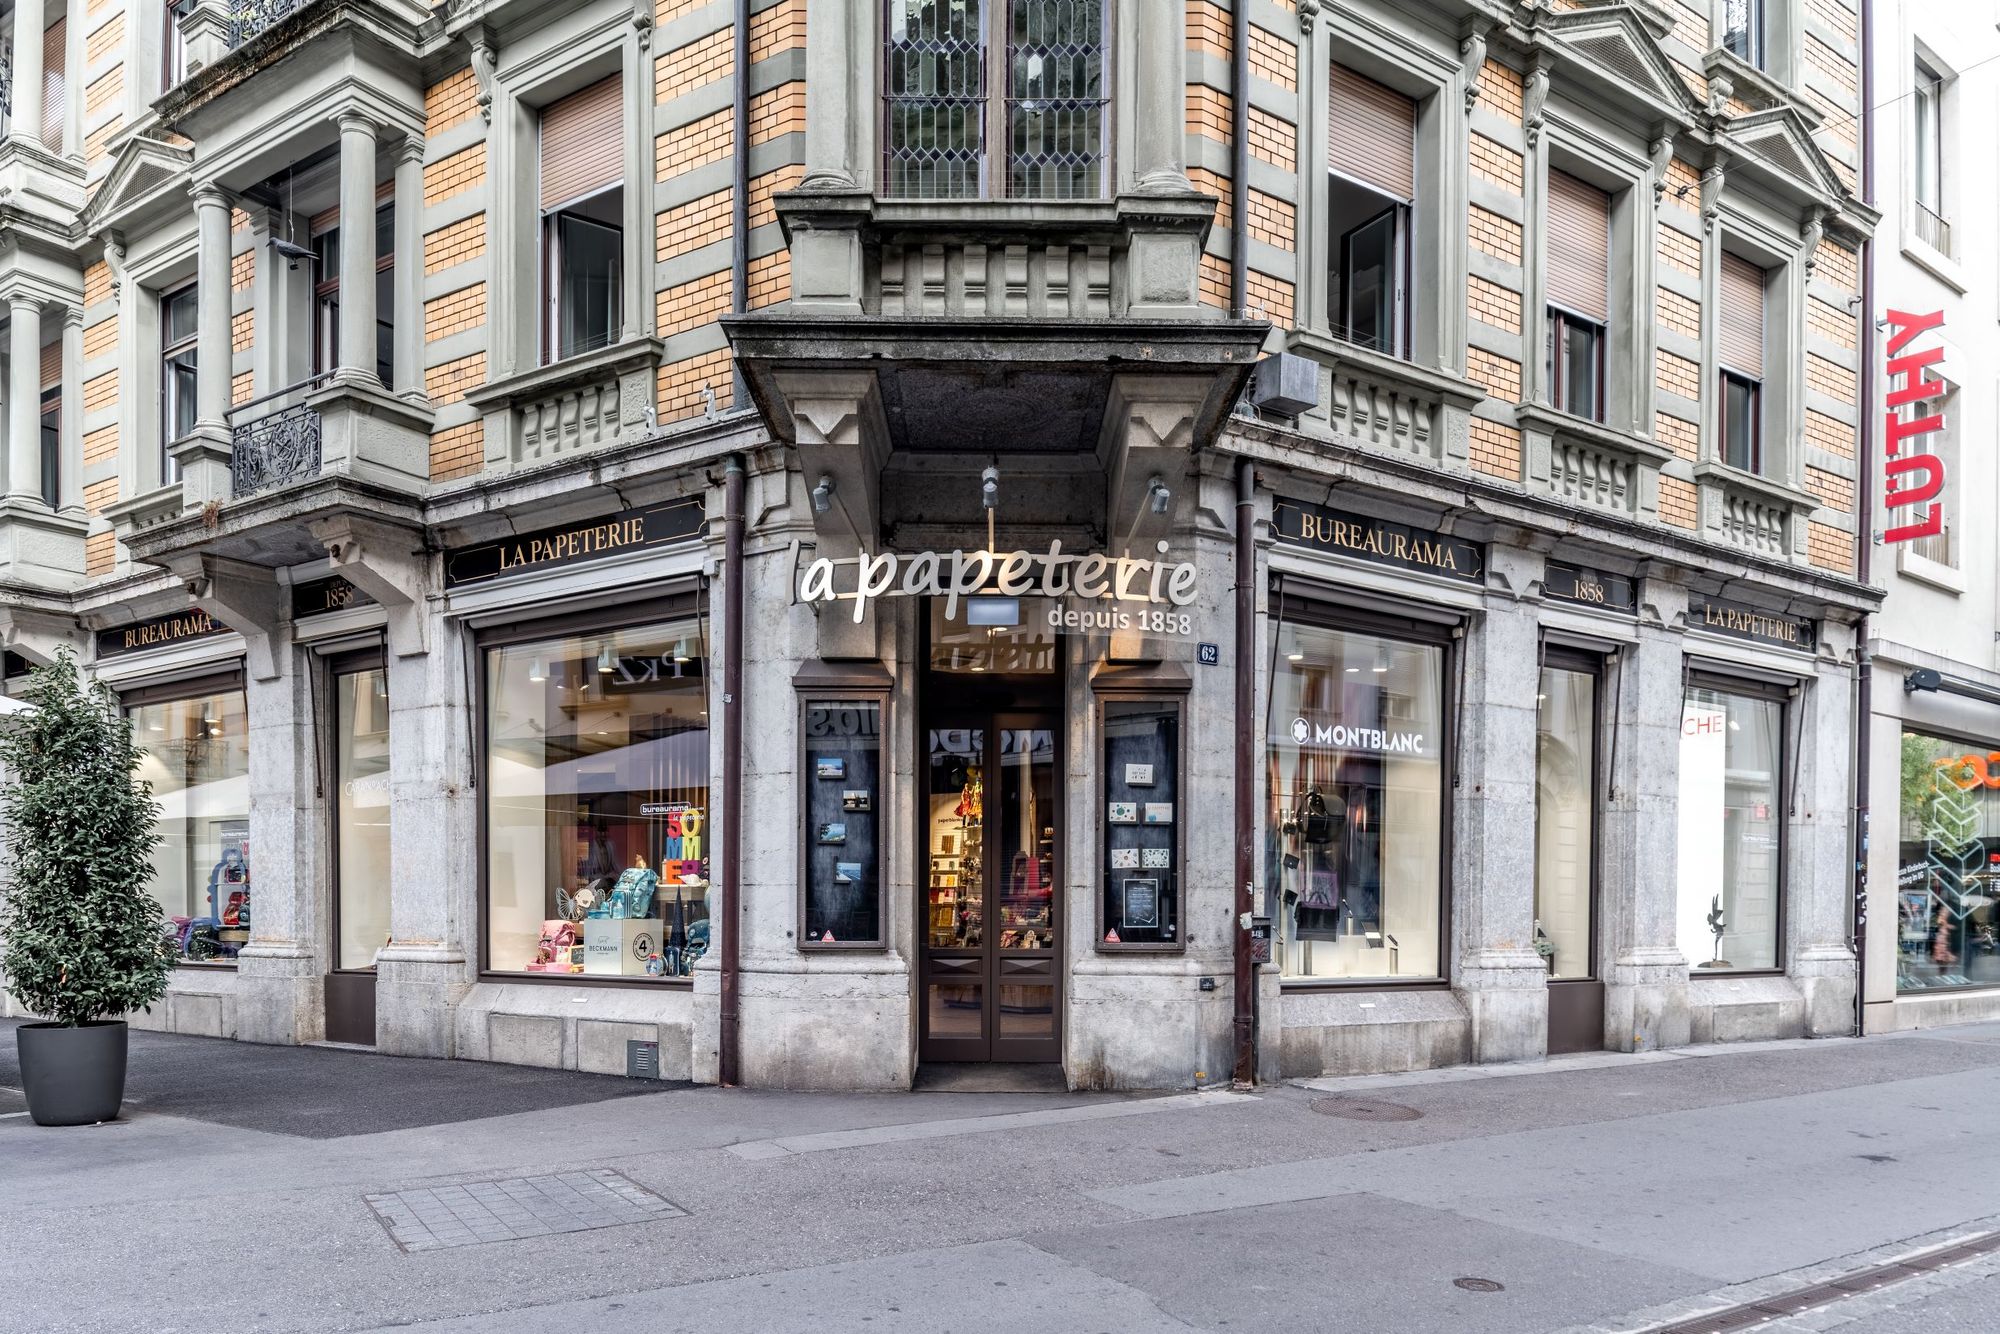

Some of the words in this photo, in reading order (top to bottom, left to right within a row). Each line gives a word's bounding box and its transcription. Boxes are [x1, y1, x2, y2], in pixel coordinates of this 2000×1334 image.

[1884, 308, 1946, 545] LÜTHY
[499, 543, 527, 570] LA
[530, 516, 645, 565] PAPETERIE
[1300, 512, 1457, 570] BUREAURAMA
[324, 585, 354, 609] 1858
[785, 538, 837, 607] la
[852, 538, 1200, 624] papeterie
[1573, 579, 1604, 603] 1858
[124, 611, 214, 649] BUREAURAMA
[1047, 604, 1131, 632] depuis
[1136, 608, 1192, 636] 1858
[1705, 603, 1726, 627] LA
[1726, 608, 1797, 642] PAPETERIE
[1201, 645, 1217, 662] 62
[1315, 722, 1424, 754] MONTBLANC
[1682, 714, 1723, 736] CHE
[588, 944, 618, 954] BECKMANN
[638, 939, 648, 954] 4
